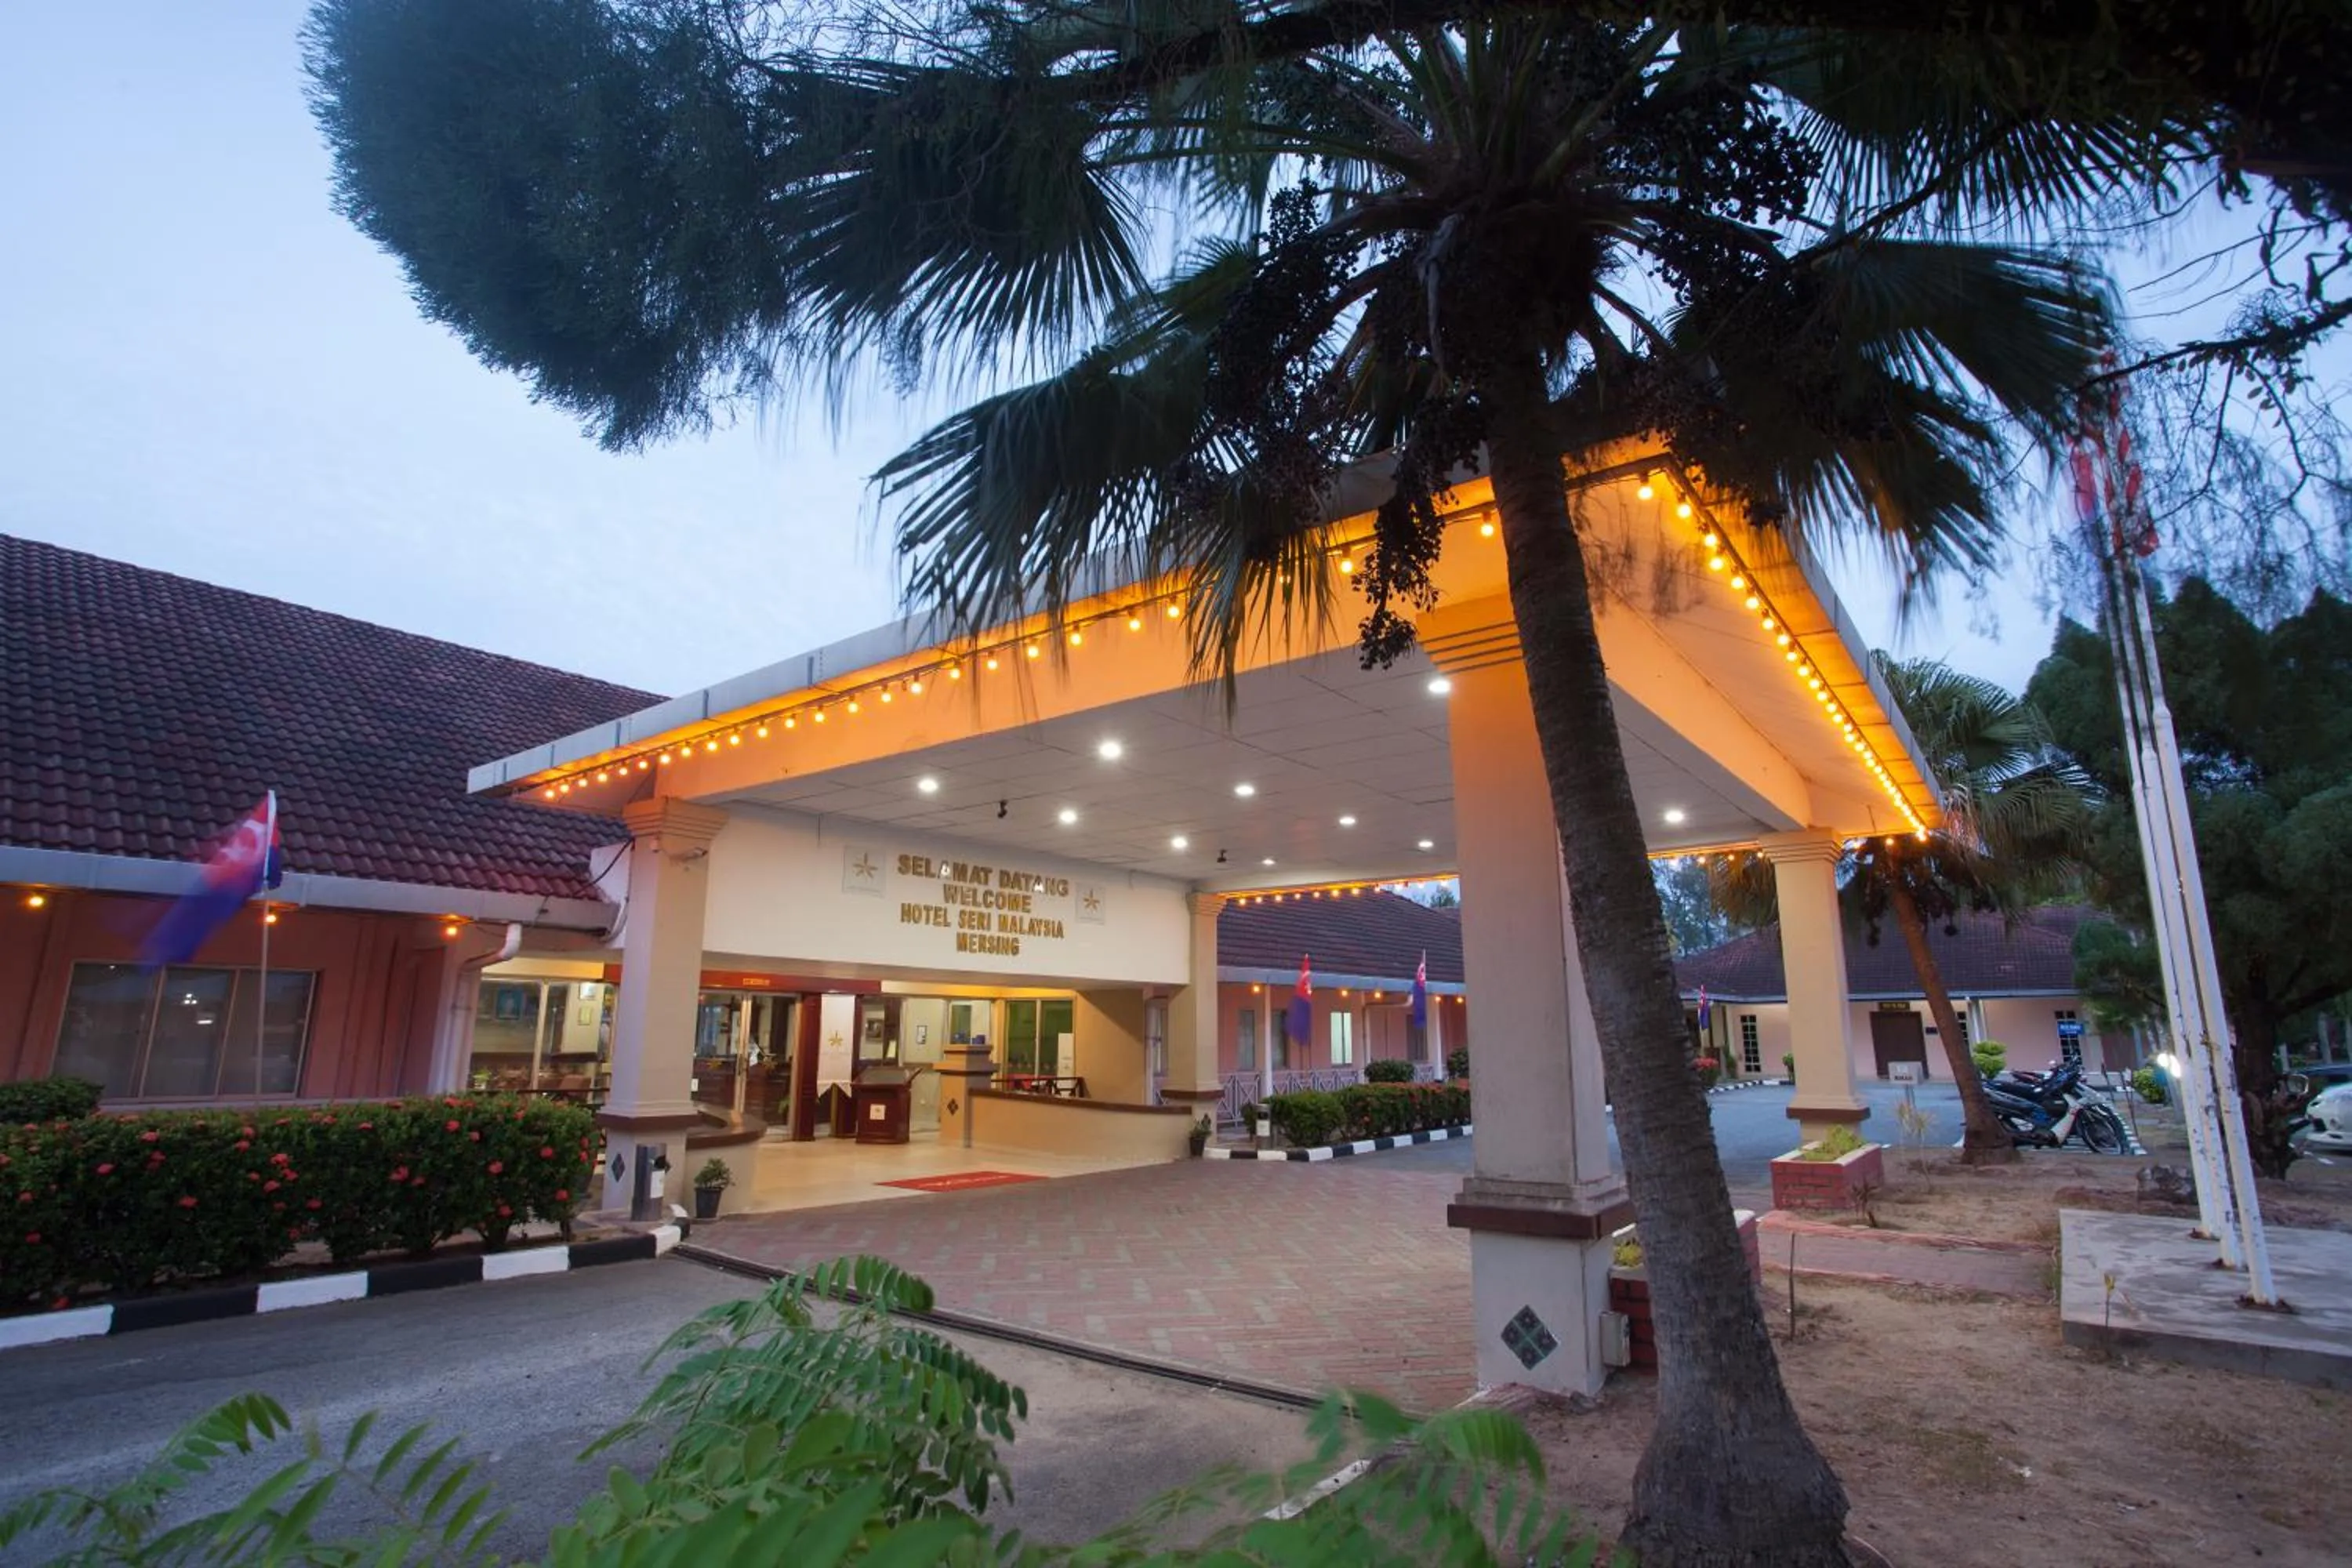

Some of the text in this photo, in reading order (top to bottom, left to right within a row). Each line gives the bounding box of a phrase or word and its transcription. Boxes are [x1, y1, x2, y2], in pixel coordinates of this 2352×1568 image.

[943, 884, 1032, 913] WELCOME
[901, 902, 1064, 938] HOTEL SERI MALAYSIA
[956, 931, 1019, 956] MERSING
